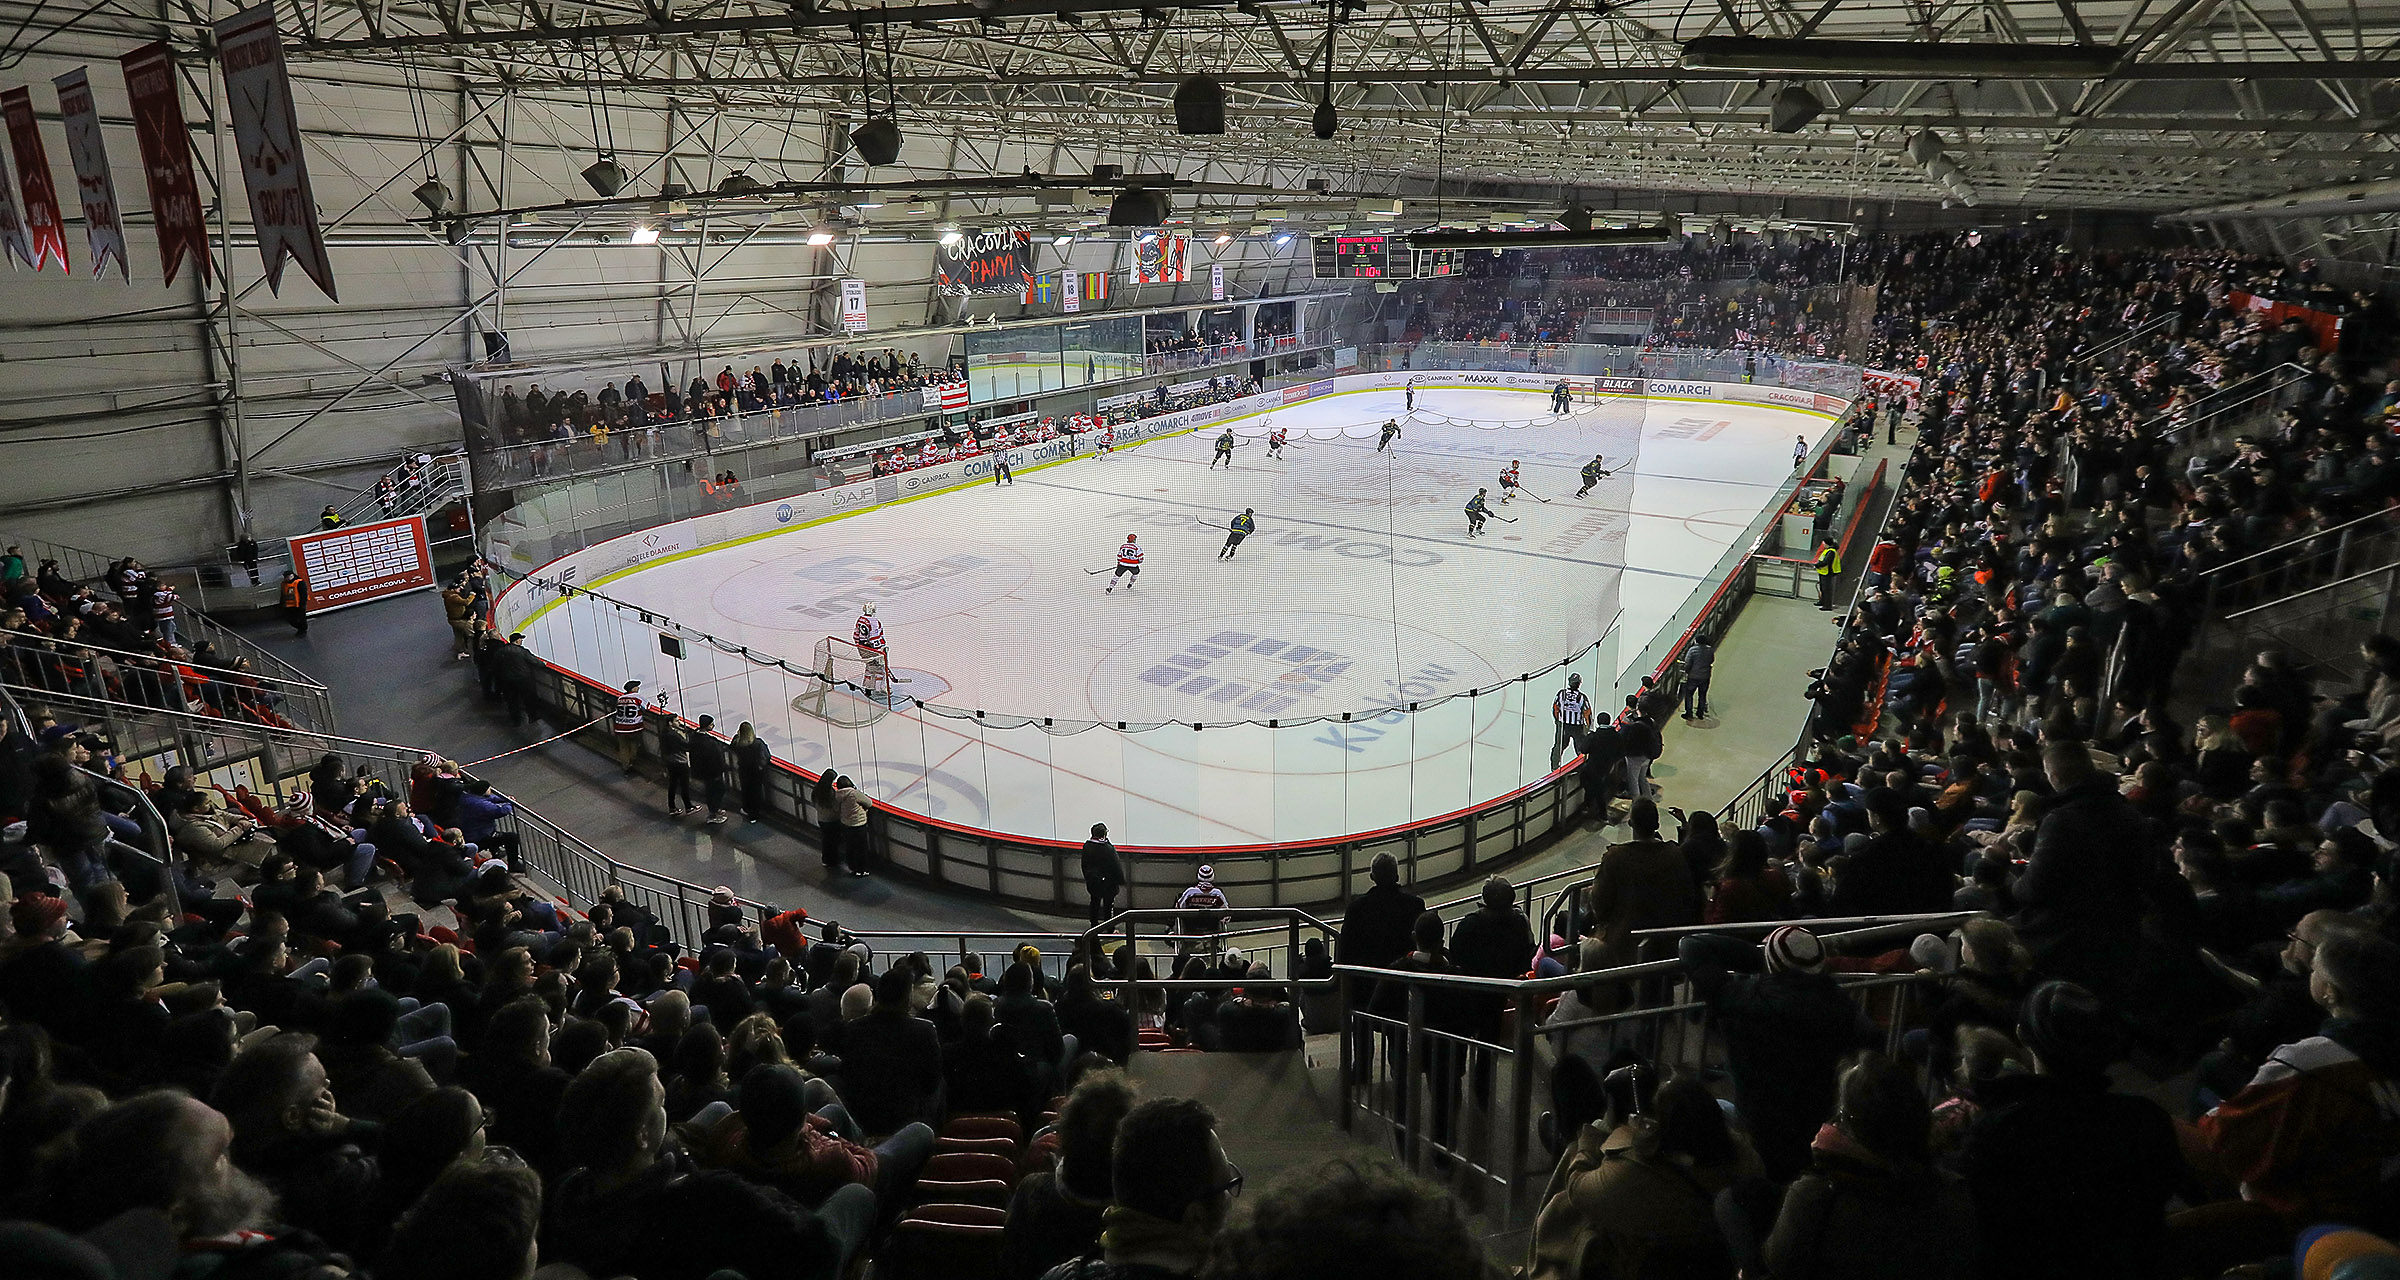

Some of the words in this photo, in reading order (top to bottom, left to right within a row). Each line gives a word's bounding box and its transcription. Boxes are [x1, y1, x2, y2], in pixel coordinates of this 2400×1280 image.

[948, 226, 1018, 261] CRACOVIA
[1339, 244, 1347, 255] 0
[1359, 246, 1365, 254] 3
[1371, 244, 1378, 254] 4
[971, 252, 1013, 284] PANY!
[849, 297, 859, 310] 17
[1464, 374, 1499, 384] MAXXX
[1602, 379, 1635, 389] BLACK
[1649, 383, 1712, 396] COMARCH
[1147, 414, 1189, 434] COMARCH
[963, 452, 1024, 477] COMCH
[921, 471, 950, 485] CANPACK
[1240, 517, 1247, 526] 7
[626, 552, 650, 564] HOTELE
[650, 542, 680, 557] DIAMENT
[328, 586, 368, 600] COMARCH
[368, 578, 407, 591] CRACOVIA
